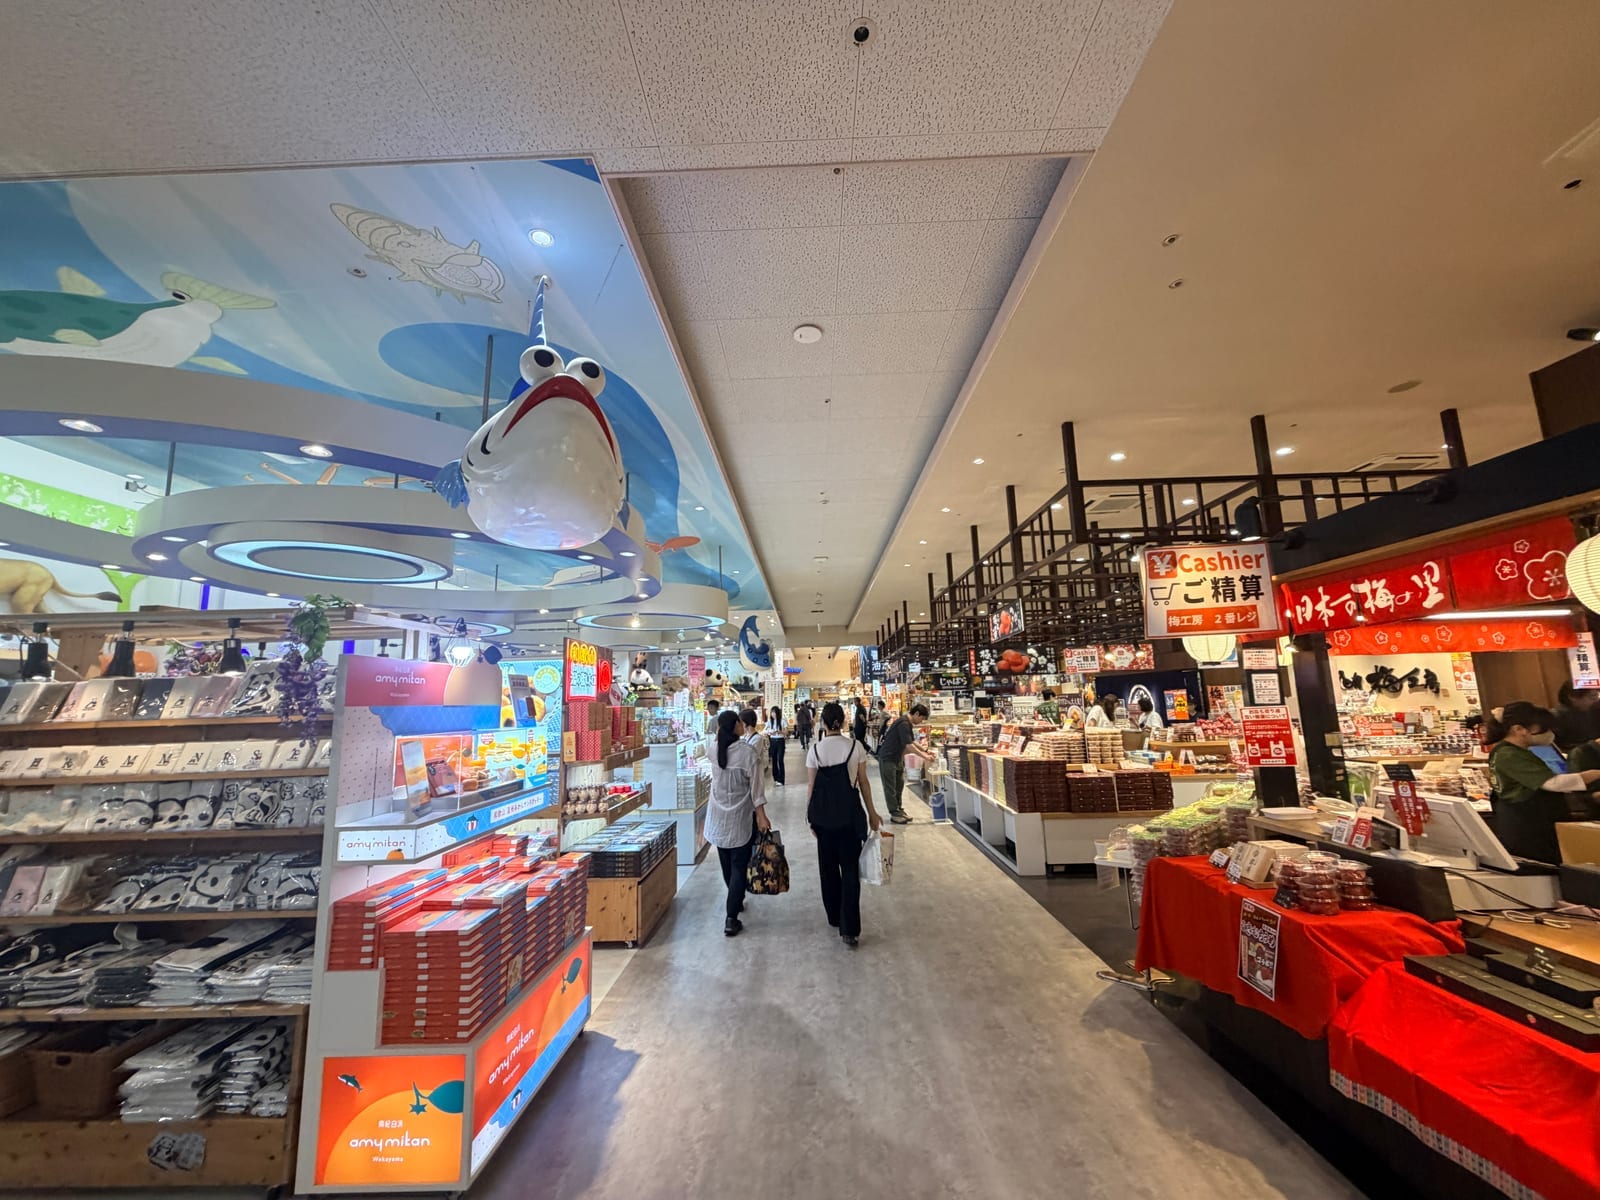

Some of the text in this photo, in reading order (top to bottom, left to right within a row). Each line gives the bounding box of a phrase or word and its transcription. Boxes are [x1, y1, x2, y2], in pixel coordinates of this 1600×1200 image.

[1179, 550, 1264, 573] Cashier
[1184, 574, 1265, 604] ご精算
[1168, 614, 1203, 627] 梅工房
